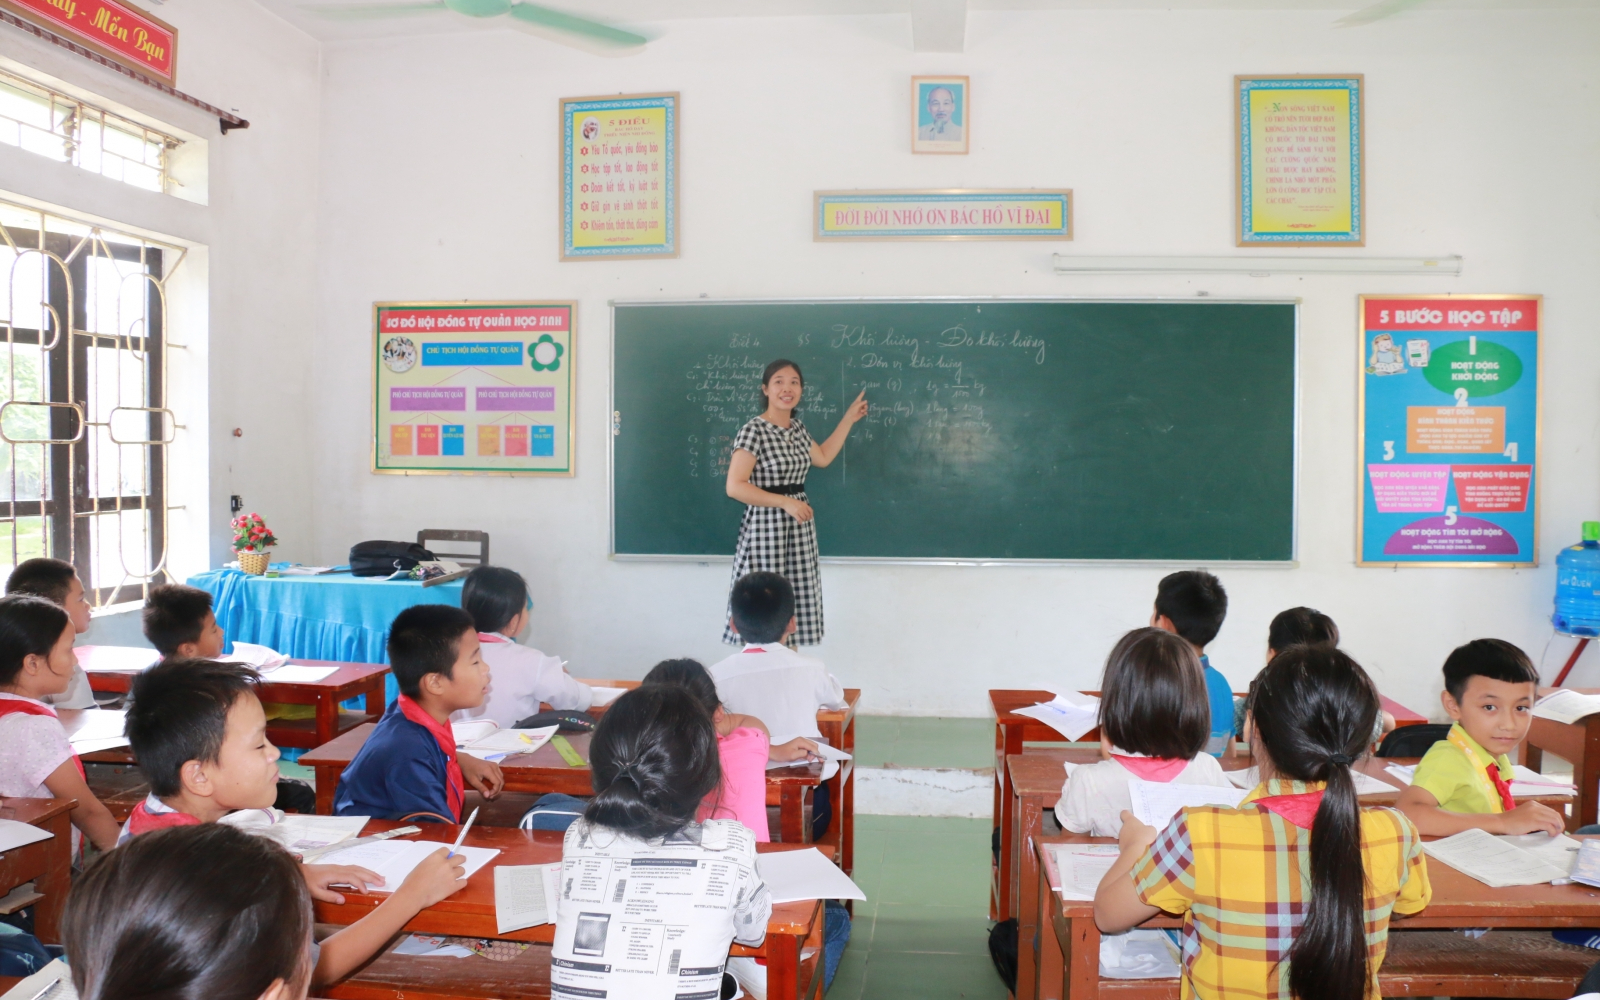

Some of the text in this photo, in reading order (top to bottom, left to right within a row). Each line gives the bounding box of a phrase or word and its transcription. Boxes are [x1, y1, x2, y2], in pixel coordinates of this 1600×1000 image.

[132, 27, 165, 61] Bạn
[609, 116, 651, 127] 5 ĐIỀU
[835, 204, 1051, 226] ĐỜI ĐỜI NHỚ ƠN BÁC HỒ VĨ ĐẠI
[386, 312, 562, 331] SƠ ĐỒ HỘI ĐỒNG TỰ QUẢN HỌC SINH
[1379, 307, 1522, 328] 5 BƯỚC HỌC TẬP
[831, 324, 876, 348] Khối
[1469, 335, 1476, 356] 1
[426, 345, 441, 355] CHỦ
[443, 346, 457, 356] TỊCH
[458, 346, 469, 356] HỘI
[470, 345, 489, 355] ĐỒNG
[500, 344, 519, 354] QUẢN
[1450, 361, 1500, 374] HOẠT ĐỘNG
[1451, 370, 1499, 383] KHỞI ĐỘNG
[1454, 387, 1468, 407] 2
[1383, 440, 1395, 461] 3
[1503, 442, 1518, 462] 4
[1444, 505, 1458, 526] 5
